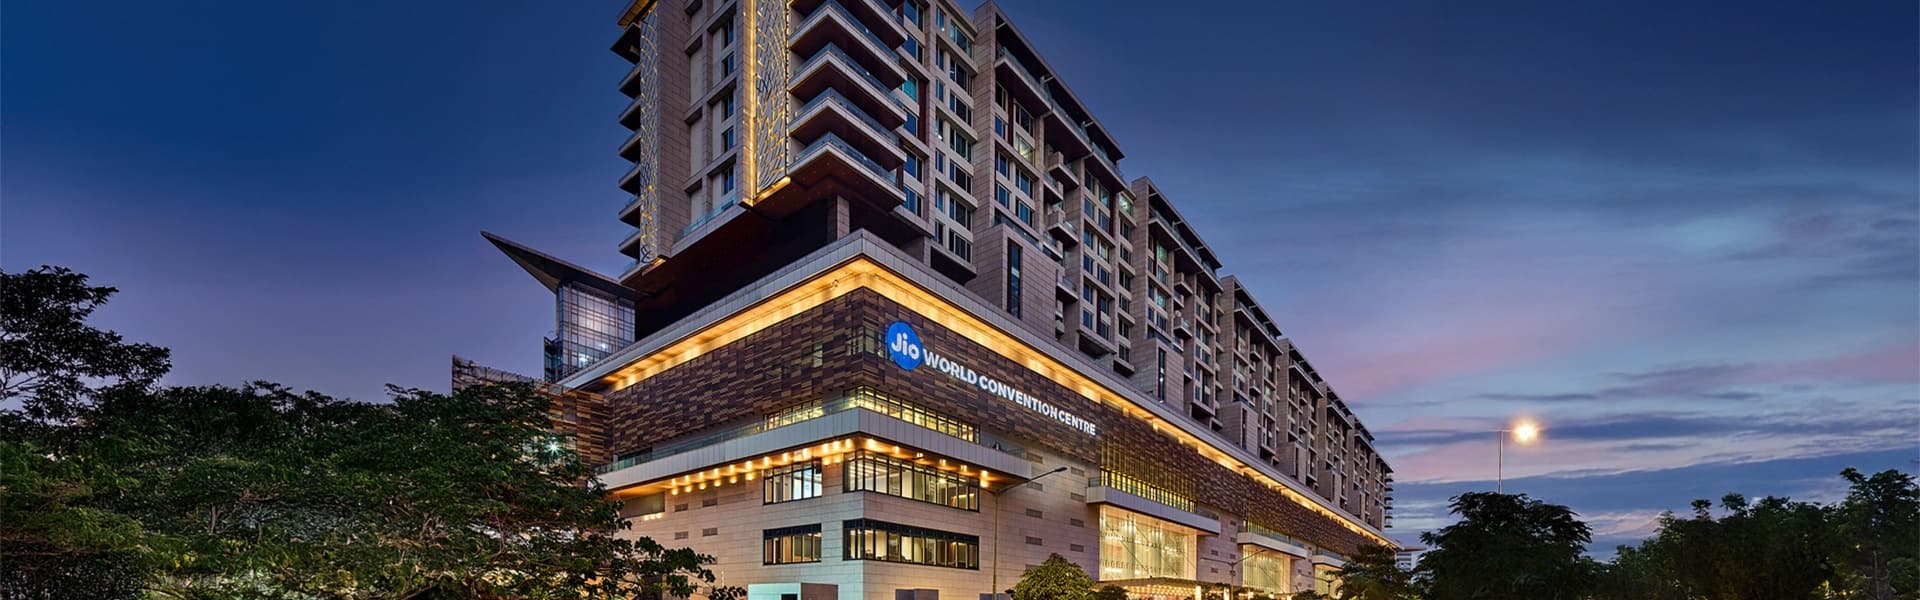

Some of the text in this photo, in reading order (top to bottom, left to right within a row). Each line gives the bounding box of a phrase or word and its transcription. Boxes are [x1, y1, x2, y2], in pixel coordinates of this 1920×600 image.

[891, 332, 1097, 436] Jio WORLD CONVENTION CENTRE
